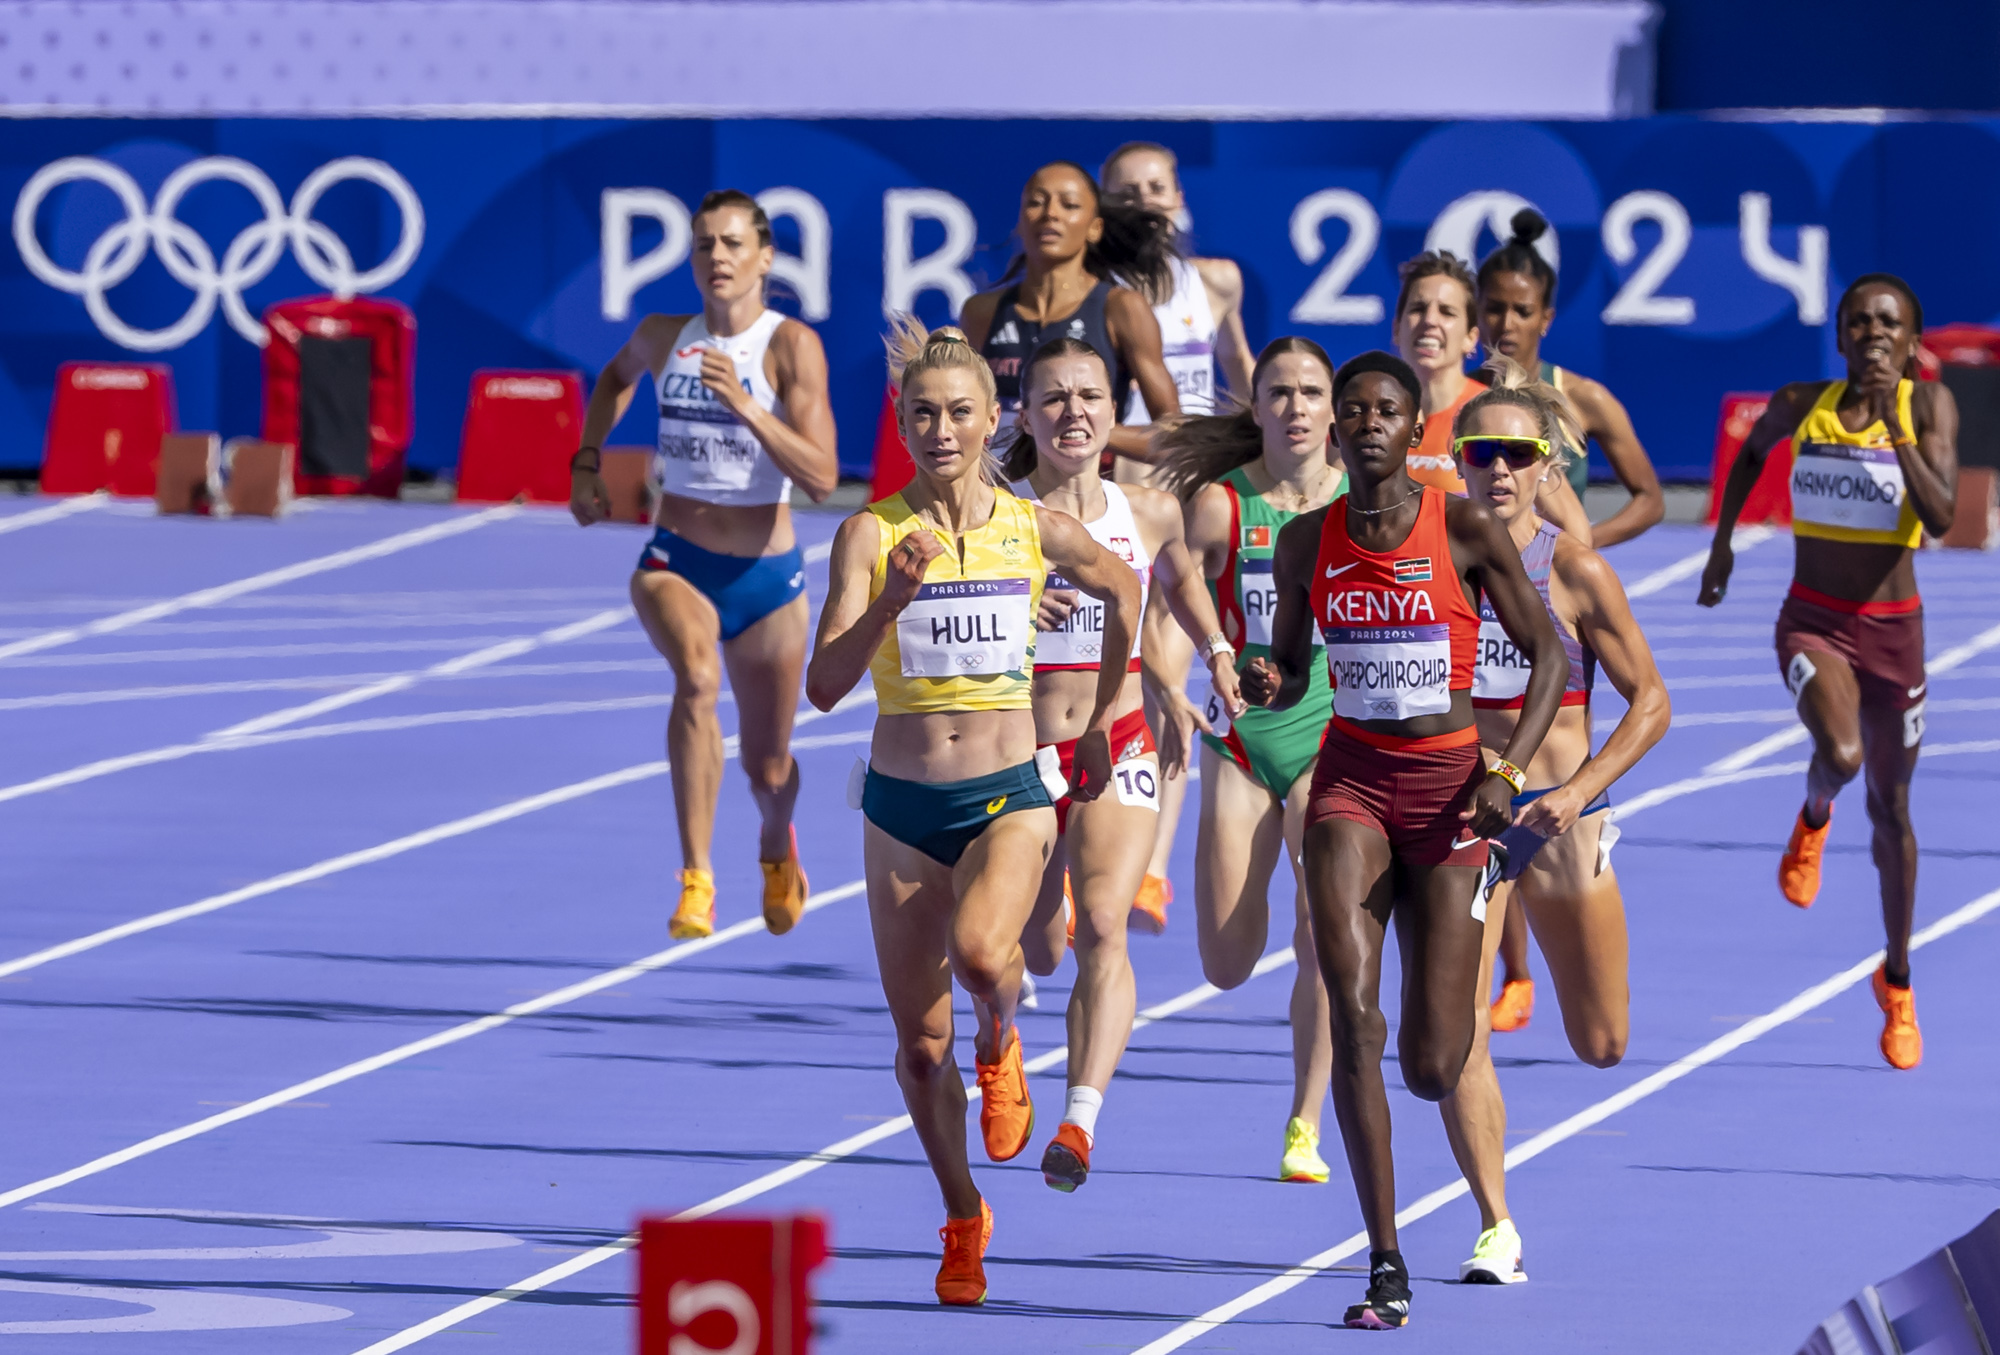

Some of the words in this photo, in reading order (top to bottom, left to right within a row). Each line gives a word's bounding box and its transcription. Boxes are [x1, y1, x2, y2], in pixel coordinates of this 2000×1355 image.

[663, 373, 752, 401] CZEA
[1792, 471, 1897, 503] NANYONDO
[931, 584, 965, 595] PARIS
[969, 583, 999, 593] 2024
[1327, 589, 1435, 622] KENYA
[931, 613, 1006, 645] HULL
[1350, 630, 1380, 639] PARIS
[1384, 630, 1415, 639] 2024
[1333, 658, 1447, 690] CHEPCHIRCHIR
[1207, 694, 1219, 723] 6
[1117, 769, 1156, 799] 10
